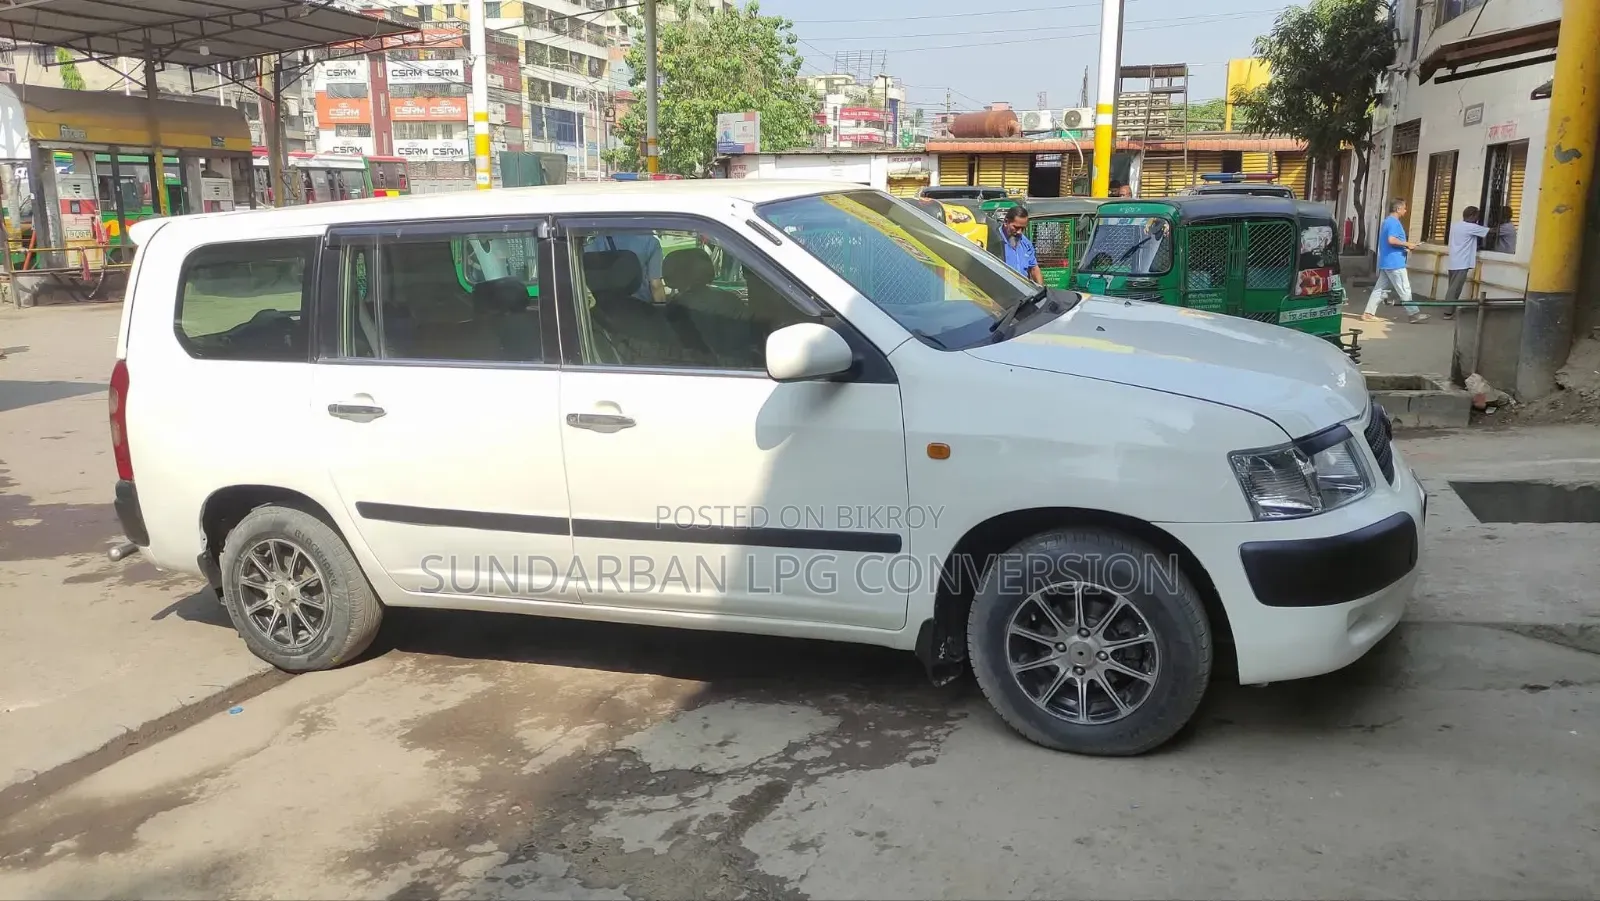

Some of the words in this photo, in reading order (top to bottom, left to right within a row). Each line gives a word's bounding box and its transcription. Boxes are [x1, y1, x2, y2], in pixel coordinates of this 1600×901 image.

[326, 68, 357, 77] CSRM
[391, 68, 423, 77] CSRM
[427, 68, 459, 77] CSRM
[329, 108, 360, 117] CSRM
[394, 106, 426, 115] CSRM
[429, 106, 461, 115] CSRM
[332, 146, 363, 154] CSRM
[398, 147, 429, 156] CSRM
[432, 147, 464, 156] CSRM
